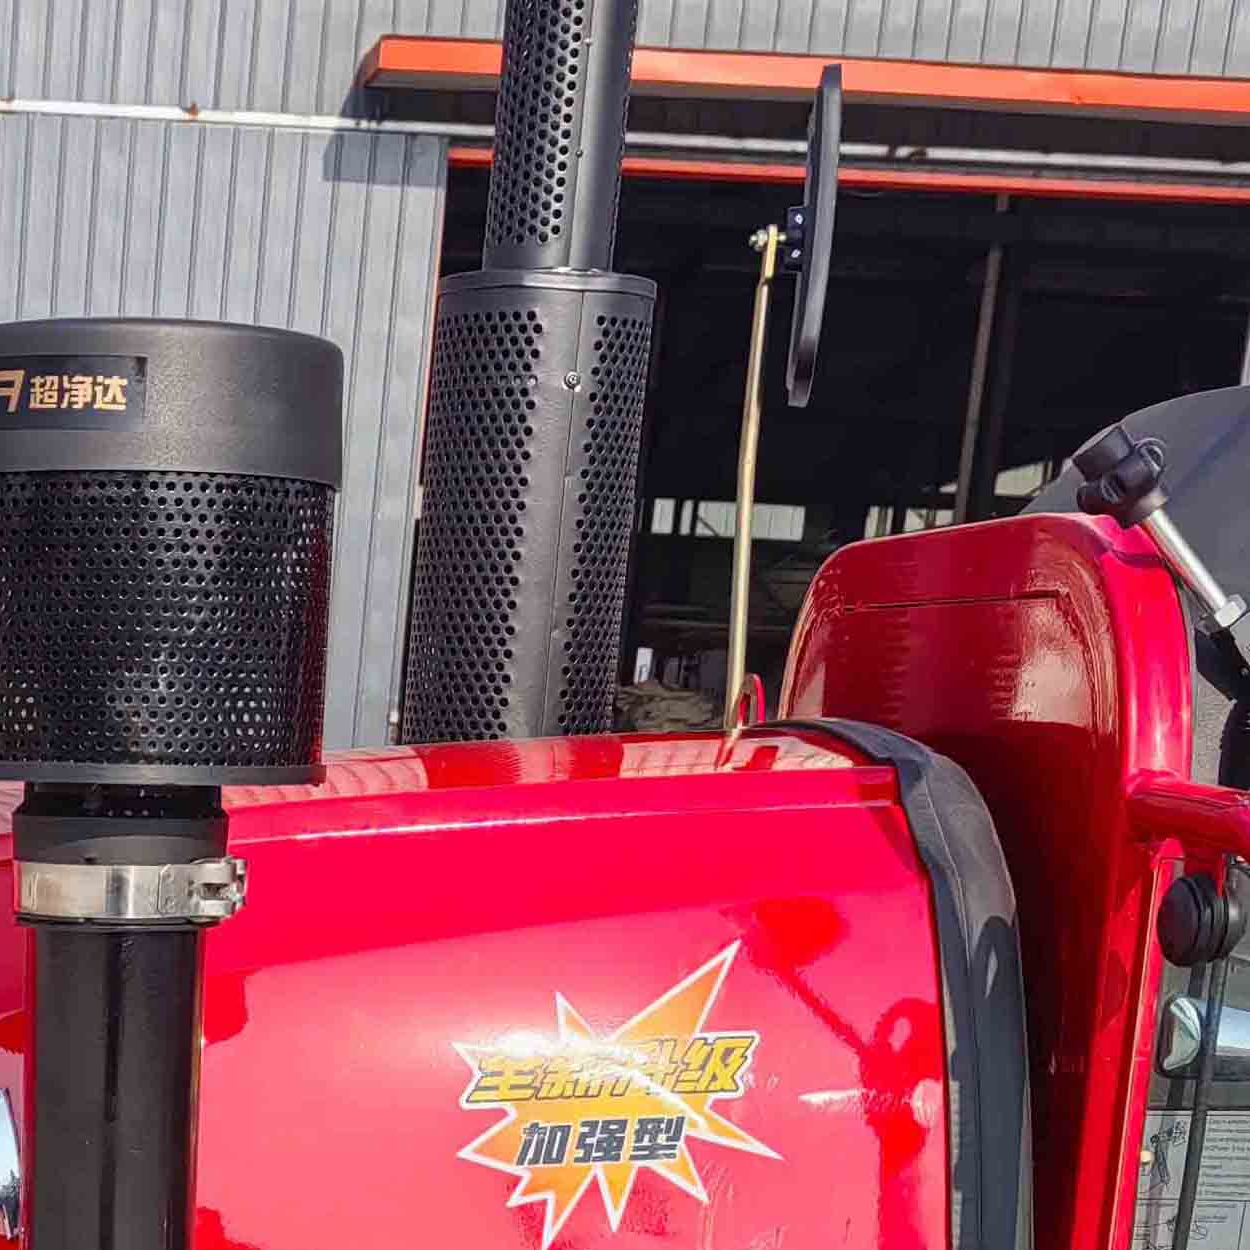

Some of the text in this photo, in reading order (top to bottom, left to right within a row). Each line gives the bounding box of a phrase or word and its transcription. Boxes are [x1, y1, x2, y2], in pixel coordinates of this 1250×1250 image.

[29, 374, 128, 411] 超净达
[516, 1116, 686, 1166] 加强型
